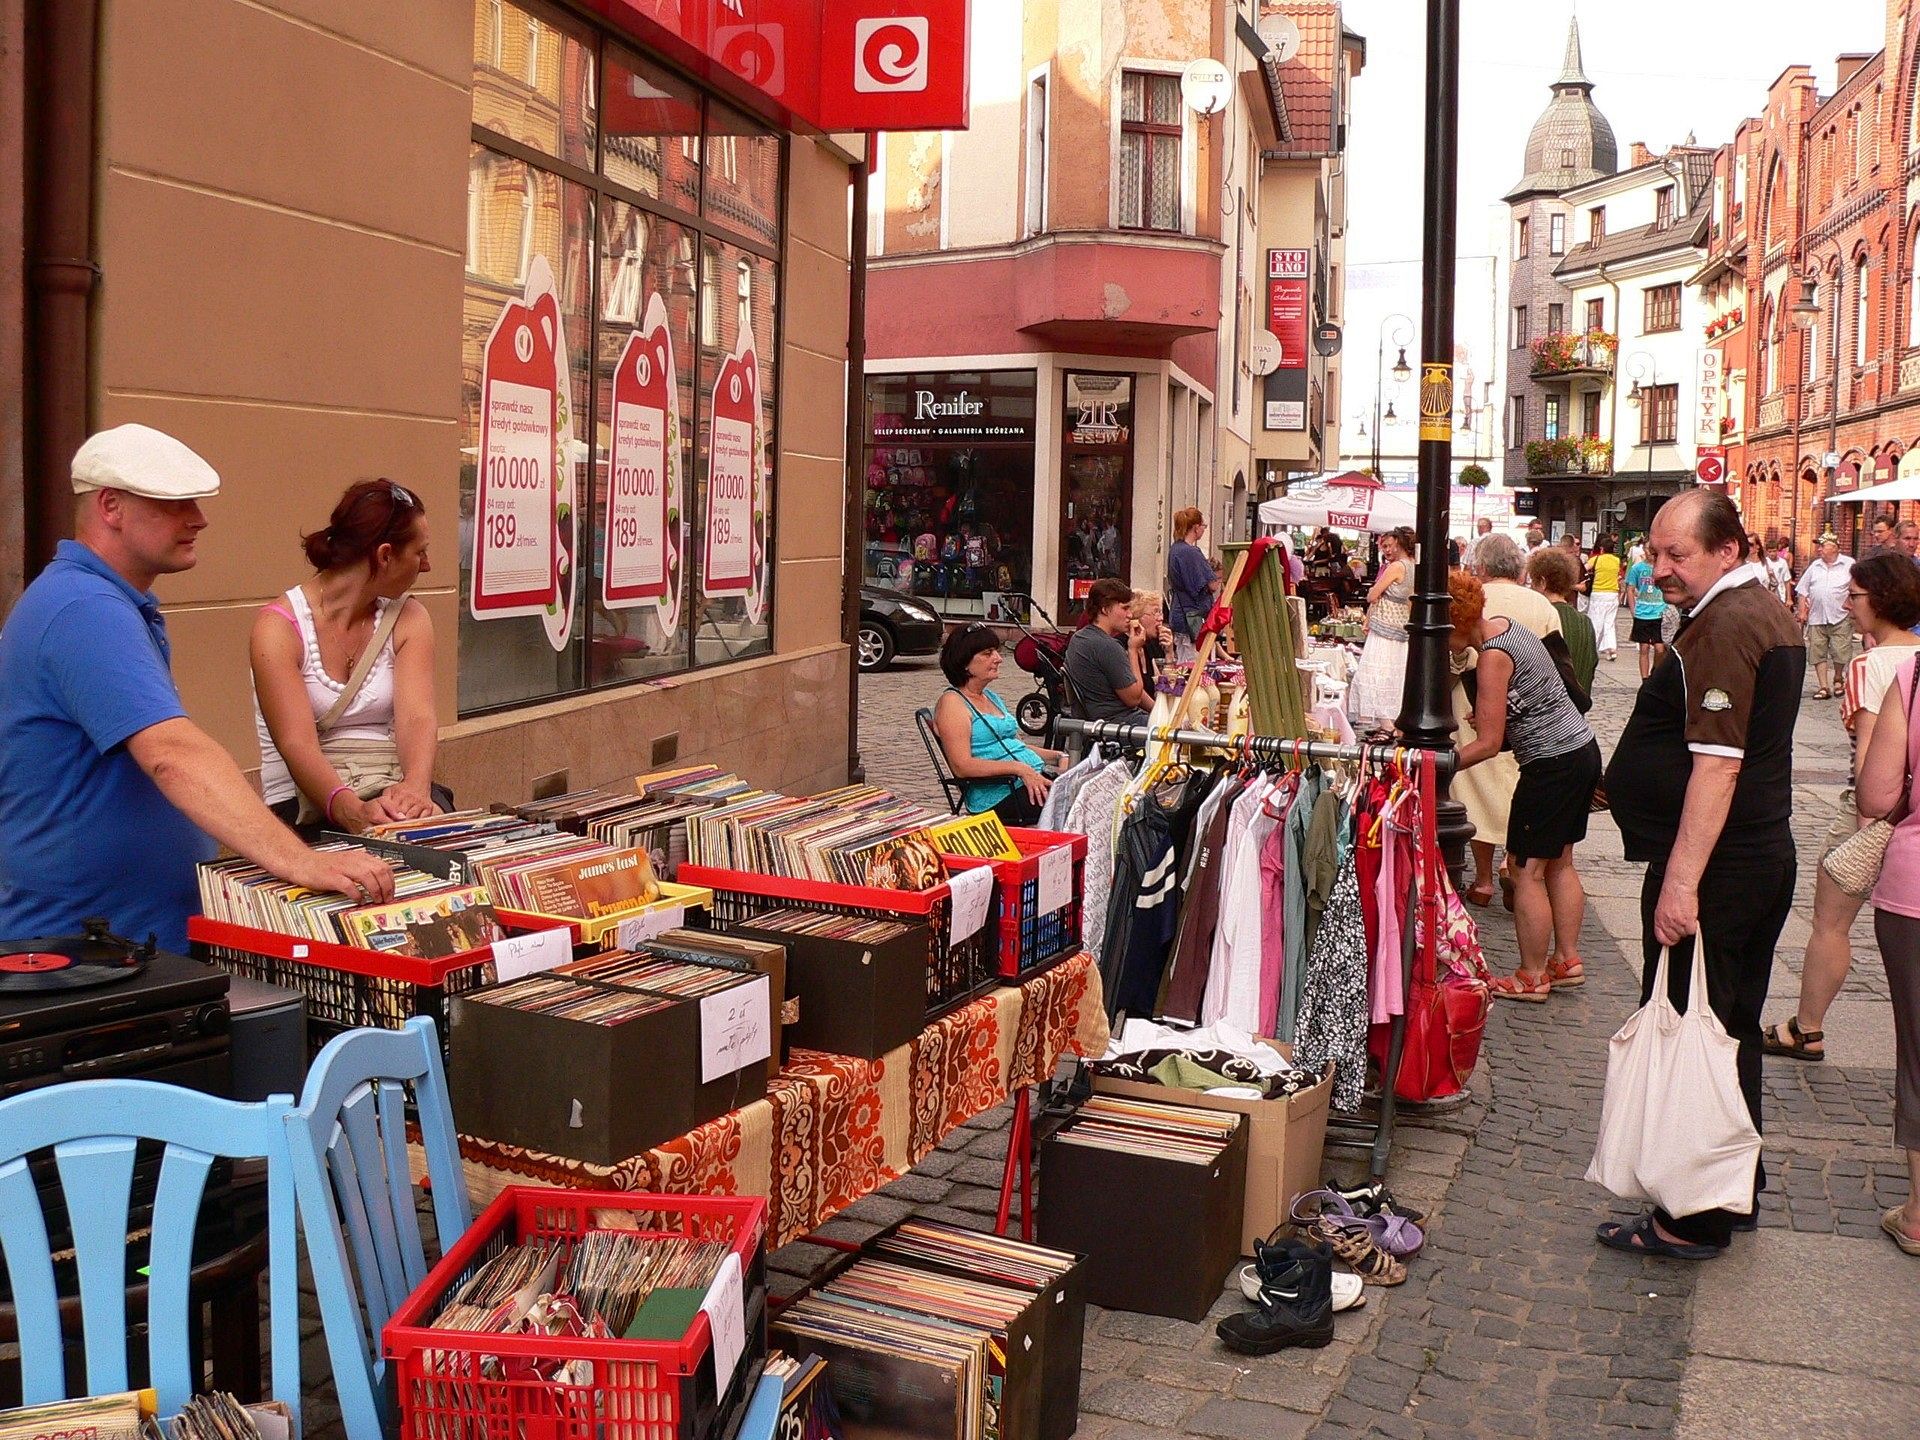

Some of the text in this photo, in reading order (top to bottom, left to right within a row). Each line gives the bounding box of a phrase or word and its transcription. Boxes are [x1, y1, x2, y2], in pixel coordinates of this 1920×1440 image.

[1275, 252, 1302, 262] STO
[1275, 263, 1302, 273] RNO
[914, 390, 984, 420] Renifer
[1700, 353, 1717, 434] OPTYK
[491, 400, 534, 415] sprawdź nasz
[490, 416, 549, 437] kredyt gotówkowy
[640, 422, 651, 432] nasz
[489, 456, 507, 489] 10
[509, 456, 539, 489] 000
[616, 467, 631, 496] 10
[631, 468, 655, 497] 000
[714, 474, 725, 499] 10
[726, 474, 744, 500] 000
[487, 499, 495, 509] 84
[487, 514, 516, 549] 189
[614, 518, 637, 548] 189
[713, 518, 731, 545] 189
[1330, 513, 1367, 527] TYSKIE
[937, 819, 1010, 859] HOLIDAY
[728, 1007, 736, 1021] 2
